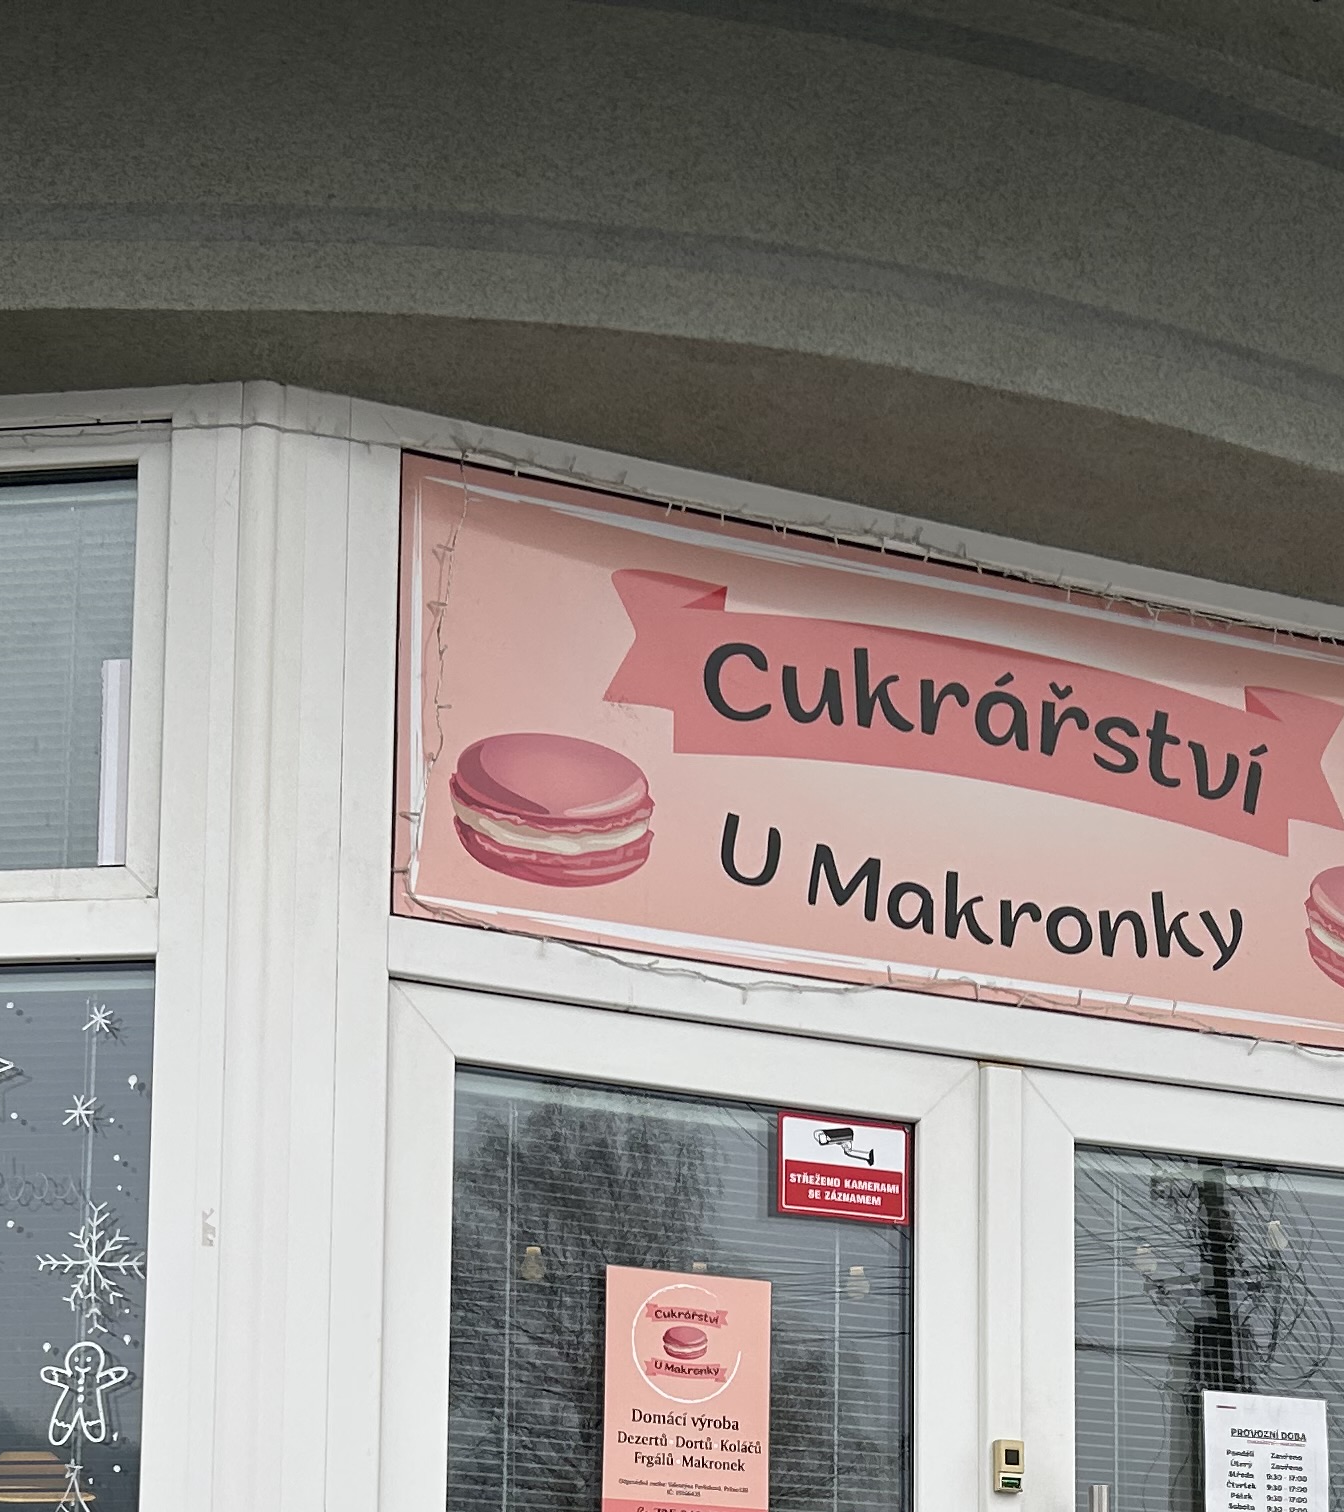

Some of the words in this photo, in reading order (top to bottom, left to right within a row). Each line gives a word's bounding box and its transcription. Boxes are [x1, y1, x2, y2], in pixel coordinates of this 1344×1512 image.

[703, 641, 1270, 816] Cukrářství
[719, 813, 782, 888] U
[807, 843, 1244, 971] Makronky
[789, 1172, 841, 1187] STŘEŽENO
[844, 1179, 900, 1194] KAMERAMI
[808, 1189, 821, 1199] SE
[824, 1189, 882, 1206] ZÁZNAMEM
[655, 1309, 719, 1324] Cukrářství
[655, 1360, 662, 1369] U
[664, 1363, 720, 1376] Makronky
[631, 1408, 687, 1426] Domácí
[690, 1414, 739, 1431] výroba
[617, 1431, 668, 1447] Dezertů
[676, 1436, 713, 1450] Dortů
[721, 1440, 762, 1454] Koláčů
[1231, 1428, 1278, 1439] PROVOZNÍ
[1281, 1431, 1306, 1442] DOBA
[634, 1452, 674, 1467] Frgálů
[682, 1455, 746, 1472] Makronek
